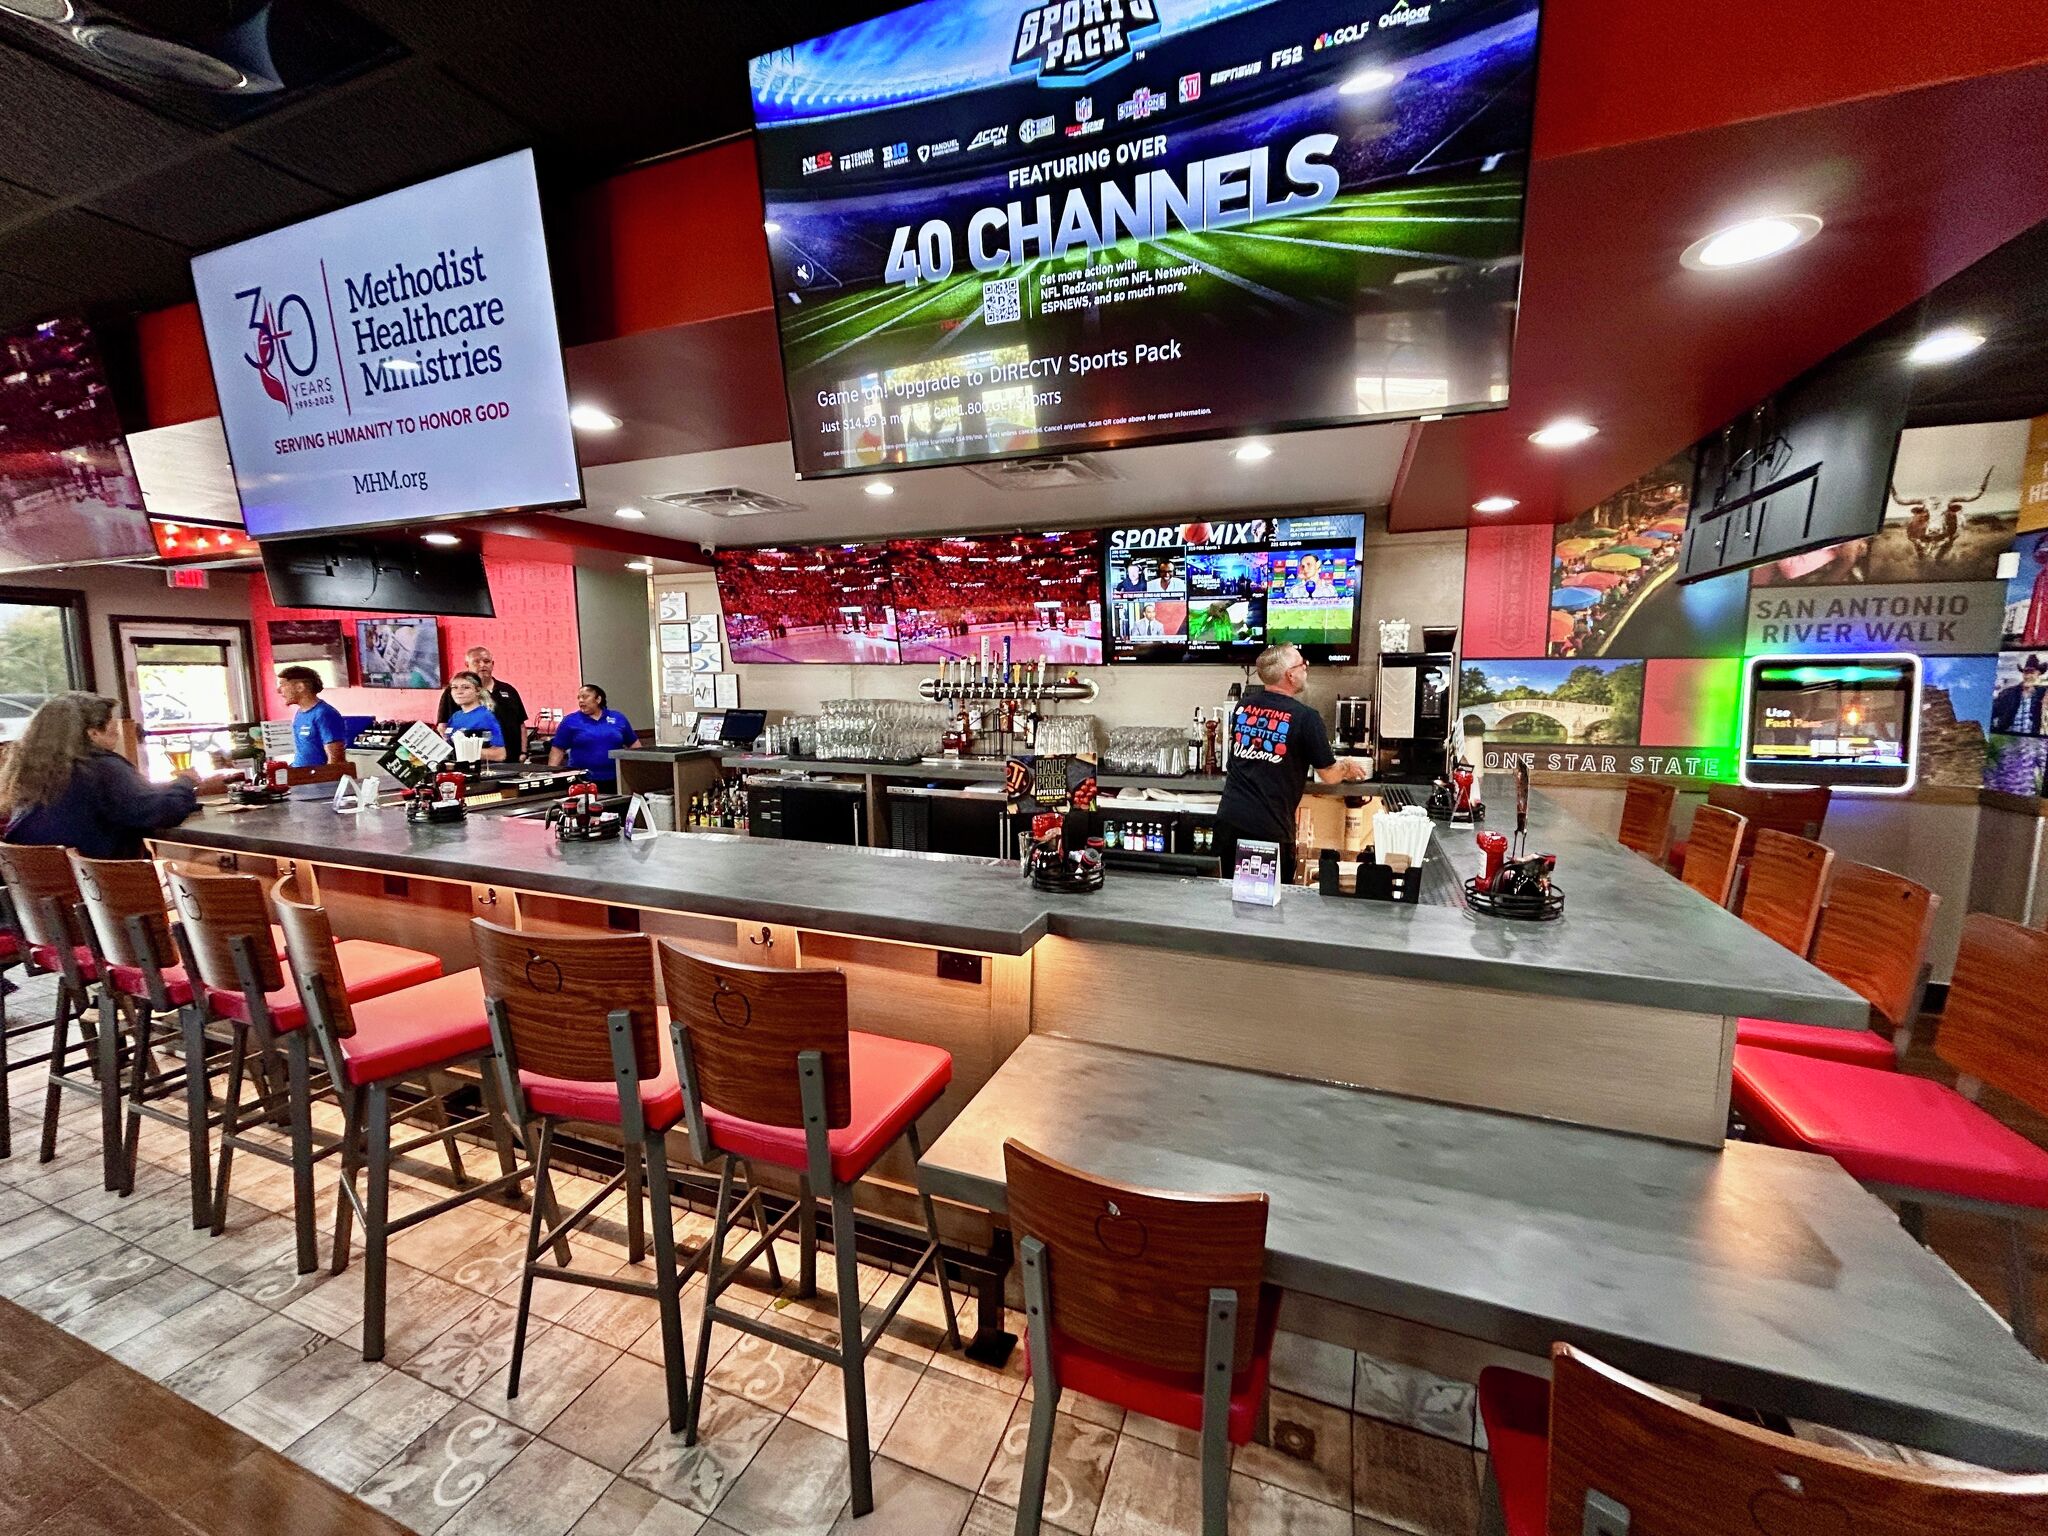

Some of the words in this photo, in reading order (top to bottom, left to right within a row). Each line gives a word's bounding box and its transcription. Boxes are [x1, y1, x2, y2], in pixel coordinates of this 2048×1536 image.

[1379, 5, 1431, 28] Outdoor
[1045, 22, 1124, 69] PACK
[1333, 21, 1370, 46] GOLF
[1271, 45, 1303, 70] FS2
[1009, 140, 1110, 189] FEATURING
[1117, 134, 1167, 166] OVER
[884, 218, 953, 288] 40
[967, 133, 1340, 273] CHANNELS
[345, 246, 487, 313] Methodist
[1040, 273, 1056, 286] Get
[1058, 270, 1083, 284] more
[1084, 264, 1114, 279] action
[1116, 258, 1137, 274] with
[1040, 288, 1060, 300] NFL
[1062, 280, 1104, 297] RedZone
[1106, 275, 1129, 289] from
[1131, 271, 1153, 285] NFL
[1155, 262, 1202, 280] Network,
[1041, 295, 1092, 314] ESPNEWS,
[1094, 292, 1112, 305] and
[1114, 290, 1125, 302] so
[1127, 284, 1155, 300] much
[352, 297, 505, 355] Healthcare
[360, 341, 503, 396] Ministries
[817, 389, 859, 407] Game
[864, 381, 889, 399] on!
[894, 373, 961, 400] Upgrade
[966, 371, 984, 387] to
[990, 356, 1062, 384] DIRECTV
[1069, 348, 1129, 376] Sports
[1135, 339, 1182, 364] Pack
[292, 377, 332, 397] YEARS
[295, 395, 335, 409] 1995-2025
[275, 433, 325, 454] SERVING
[327, 420, 393, 446] HUMANITY
[396, 417, 416, 435] TO
[419, 408, 472, 431] HONOR
[475, 401, 510, 422] GOD
[820, 419, 841, 434] Just
[842, 415, 877, 432] $14.99
[881, 416, 887, 426] a
[1044, 424, 1062, 433] Cancel
[1088, 420, 1102, 428] Scan
[1103, 418, 1112, 426] QR
[1113, 417, 1127, 425] code
[1128, 415, 1146, 423] above
[1147, 413, 1156, 421] for
[1157, 412, 1173, 420] more
[353, 470, 429, 495] MHM.org
[1111, 526, 1196, 549] SPORT
[1206, 522, 1252, 545] MIX
[1756, 599, 1815, 619] SAN
[1825, 595, 1969, 618] ANTONIO
[1762, 623, 1851, 643] RIVER
[1865, 620, 1958, 642] WALK
[1244, 704, 1291, 722] ANYTIME
[1765, 718, 1792, 728] Fast
[1766, 707, 1791, 717] Use
[1234, 724, 1287, 743] APPETITES
[1233, 741, 1283, 763] Welcome
[1036, 759, 1066, 775] HALF
[1548, 753, 1617, 773] STAR
[1630, 756, 1720, 776] STATE
[1036, 775, 1067, 789] PRICE
[1036, 788, 1066, 796] APPETIZERS
